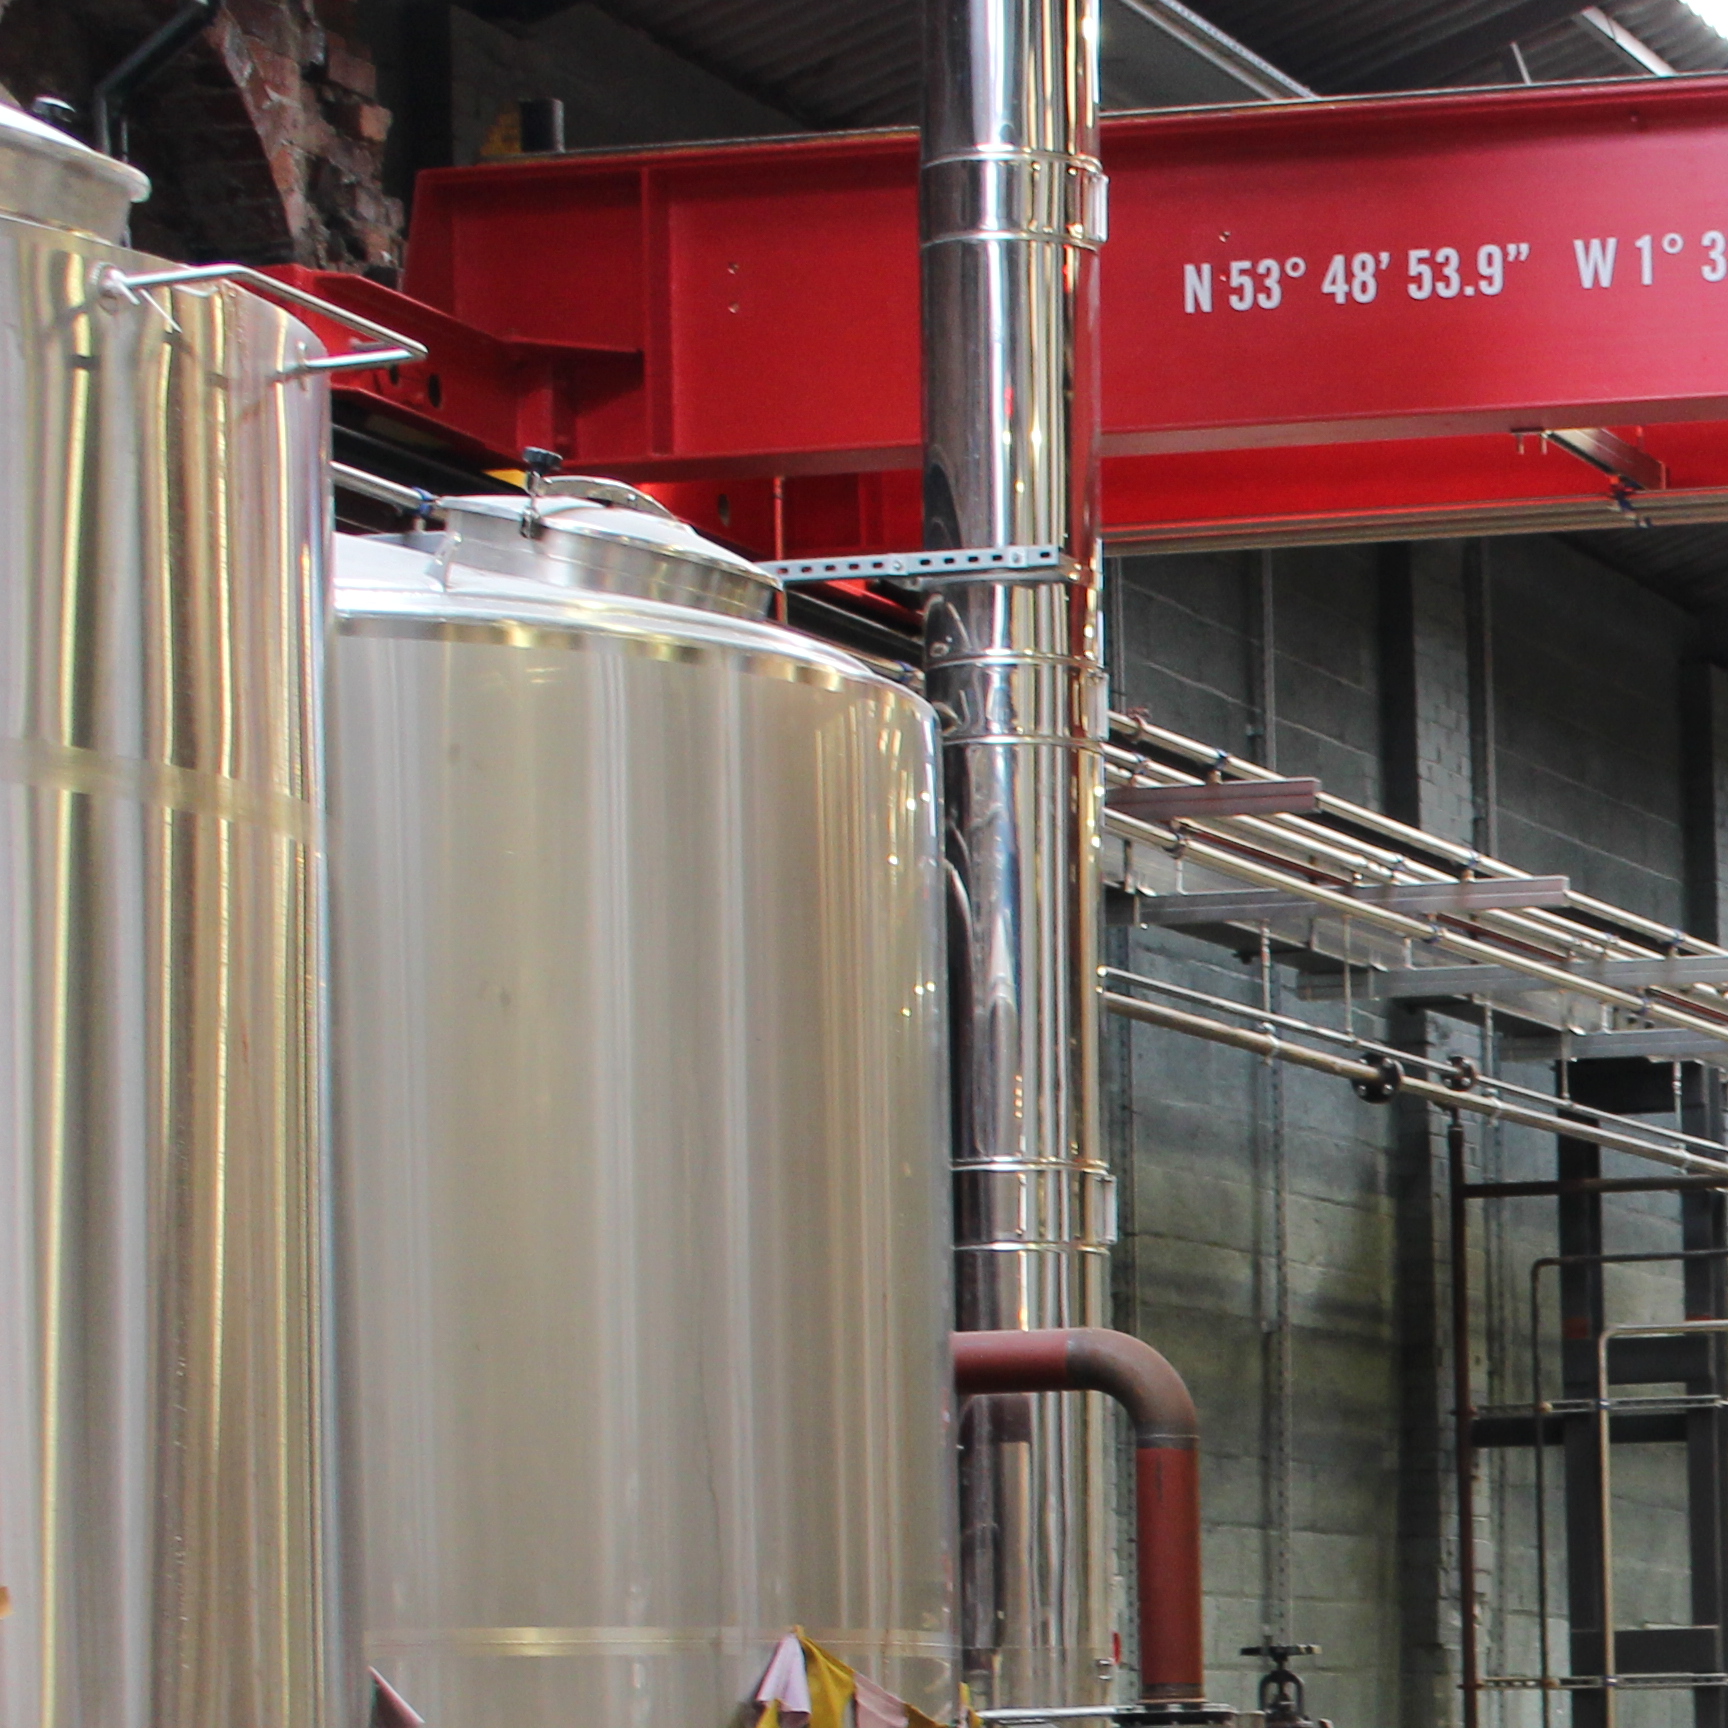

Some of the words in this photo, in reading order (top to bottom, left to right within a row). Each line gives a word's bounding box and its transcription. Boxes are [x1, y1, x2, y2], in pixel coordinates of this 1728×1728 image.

[1183, 262, 1213, 315] N
[1228, 255, 1307, 312] 53°
[1320, 251, 1391, 306] 48'
[1406, 242, 1531, 301] 53.9"
[1573, 236, 1618, 290] W
[1634, 232, 1685, 286] 1°
